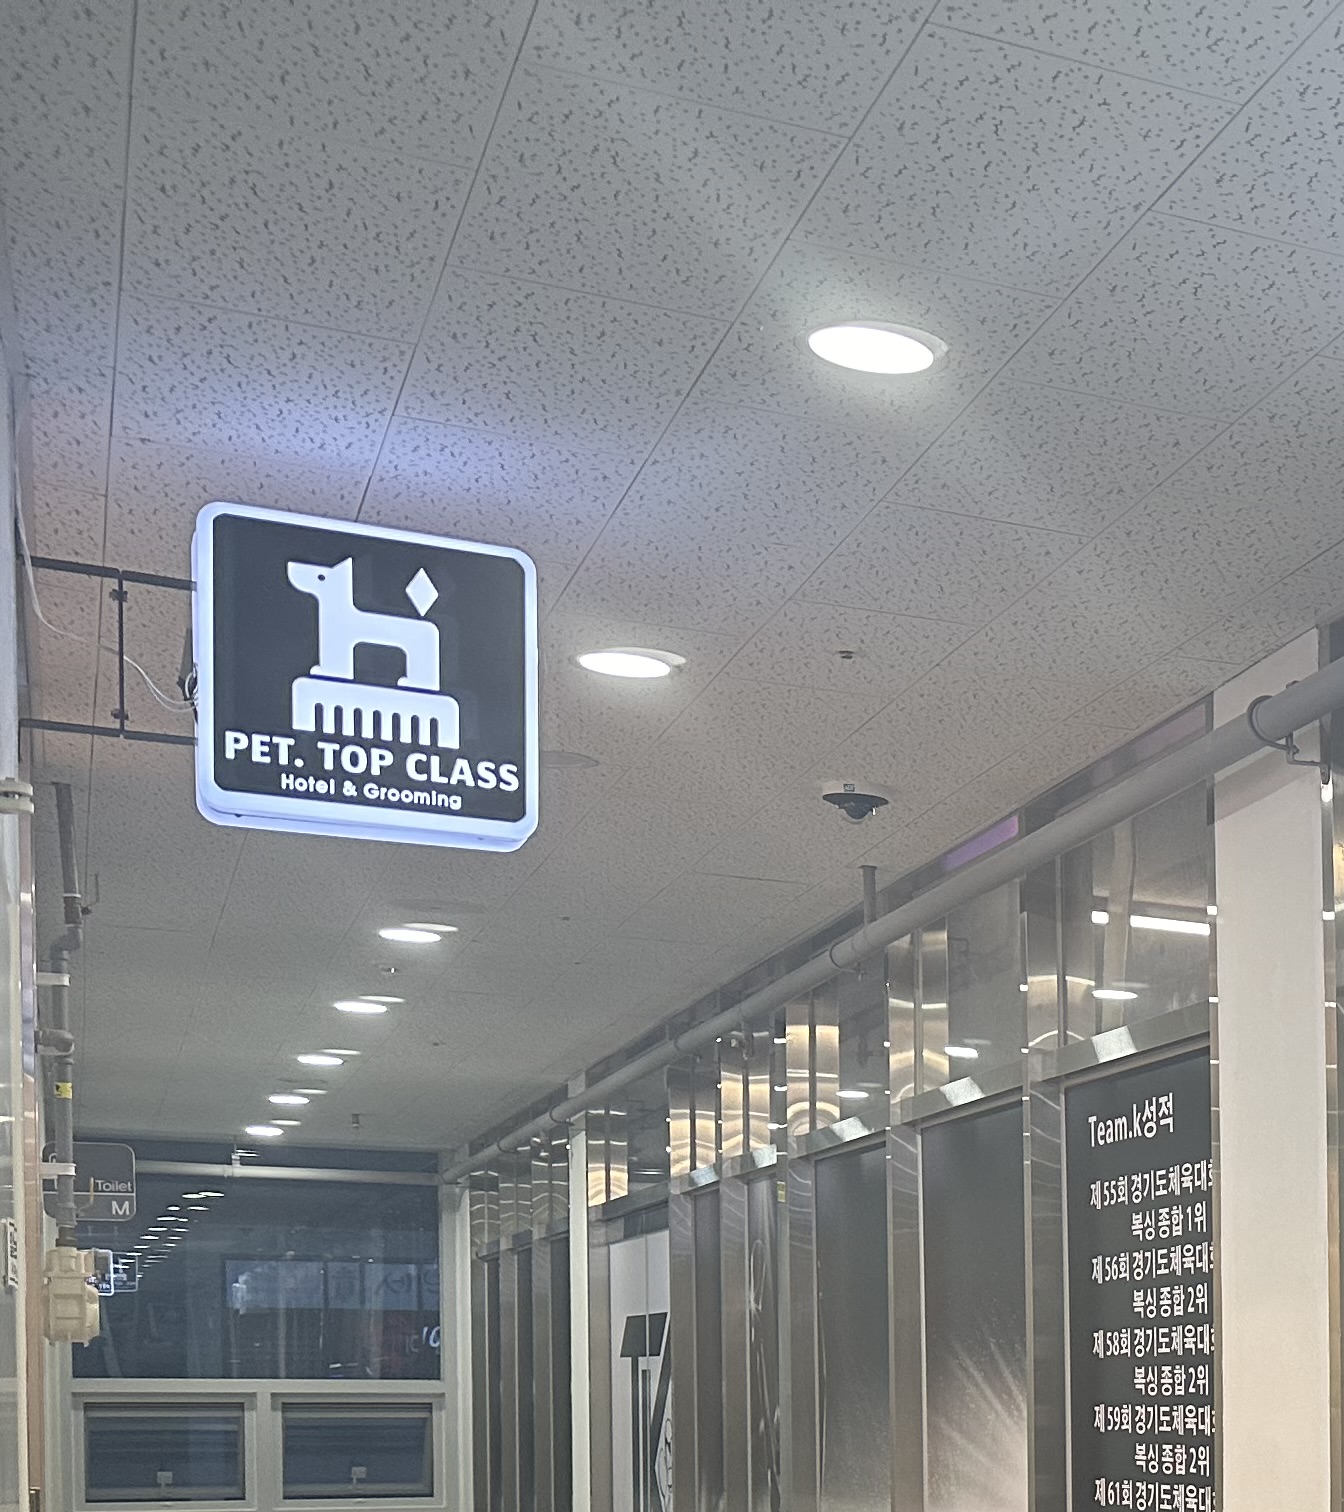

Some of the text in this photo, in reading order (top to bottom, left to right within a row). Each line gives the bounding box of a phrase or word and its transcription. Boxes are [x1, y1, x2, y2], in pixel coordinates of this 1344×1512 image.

[224, 730, 520, 792] PET. TOP CLASS
[280, 772, 462, 810] Hotel & Grooming
[95, 1180, 133, 1193] Toilet
[111, 1200, 130, 1216] M
